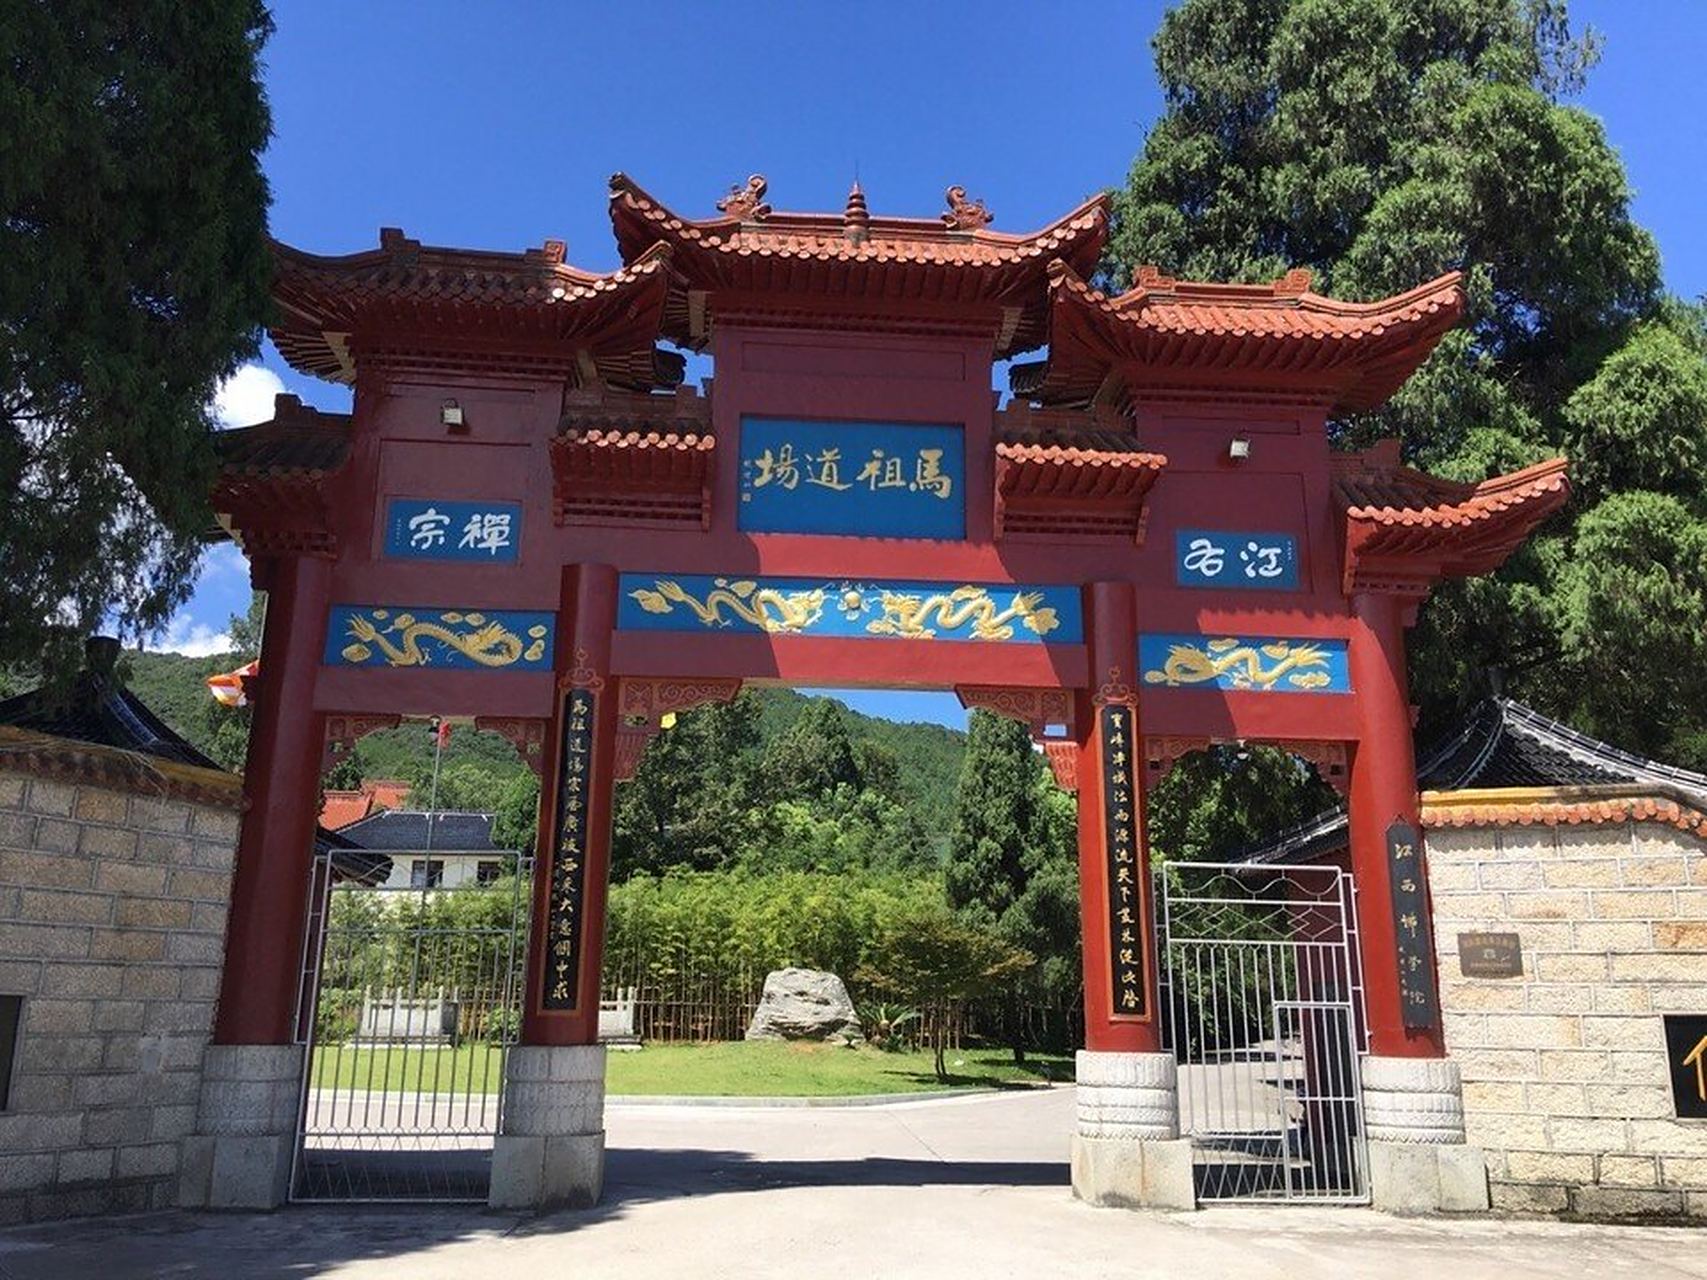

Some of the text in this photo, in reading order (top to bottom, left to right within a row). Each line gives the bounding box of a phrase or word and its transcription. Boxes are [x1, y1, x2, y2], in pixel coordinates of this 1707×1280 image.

[753, 443, 953, 499] 馬祖道場
[408, 508, 512, 555] 禪宗
